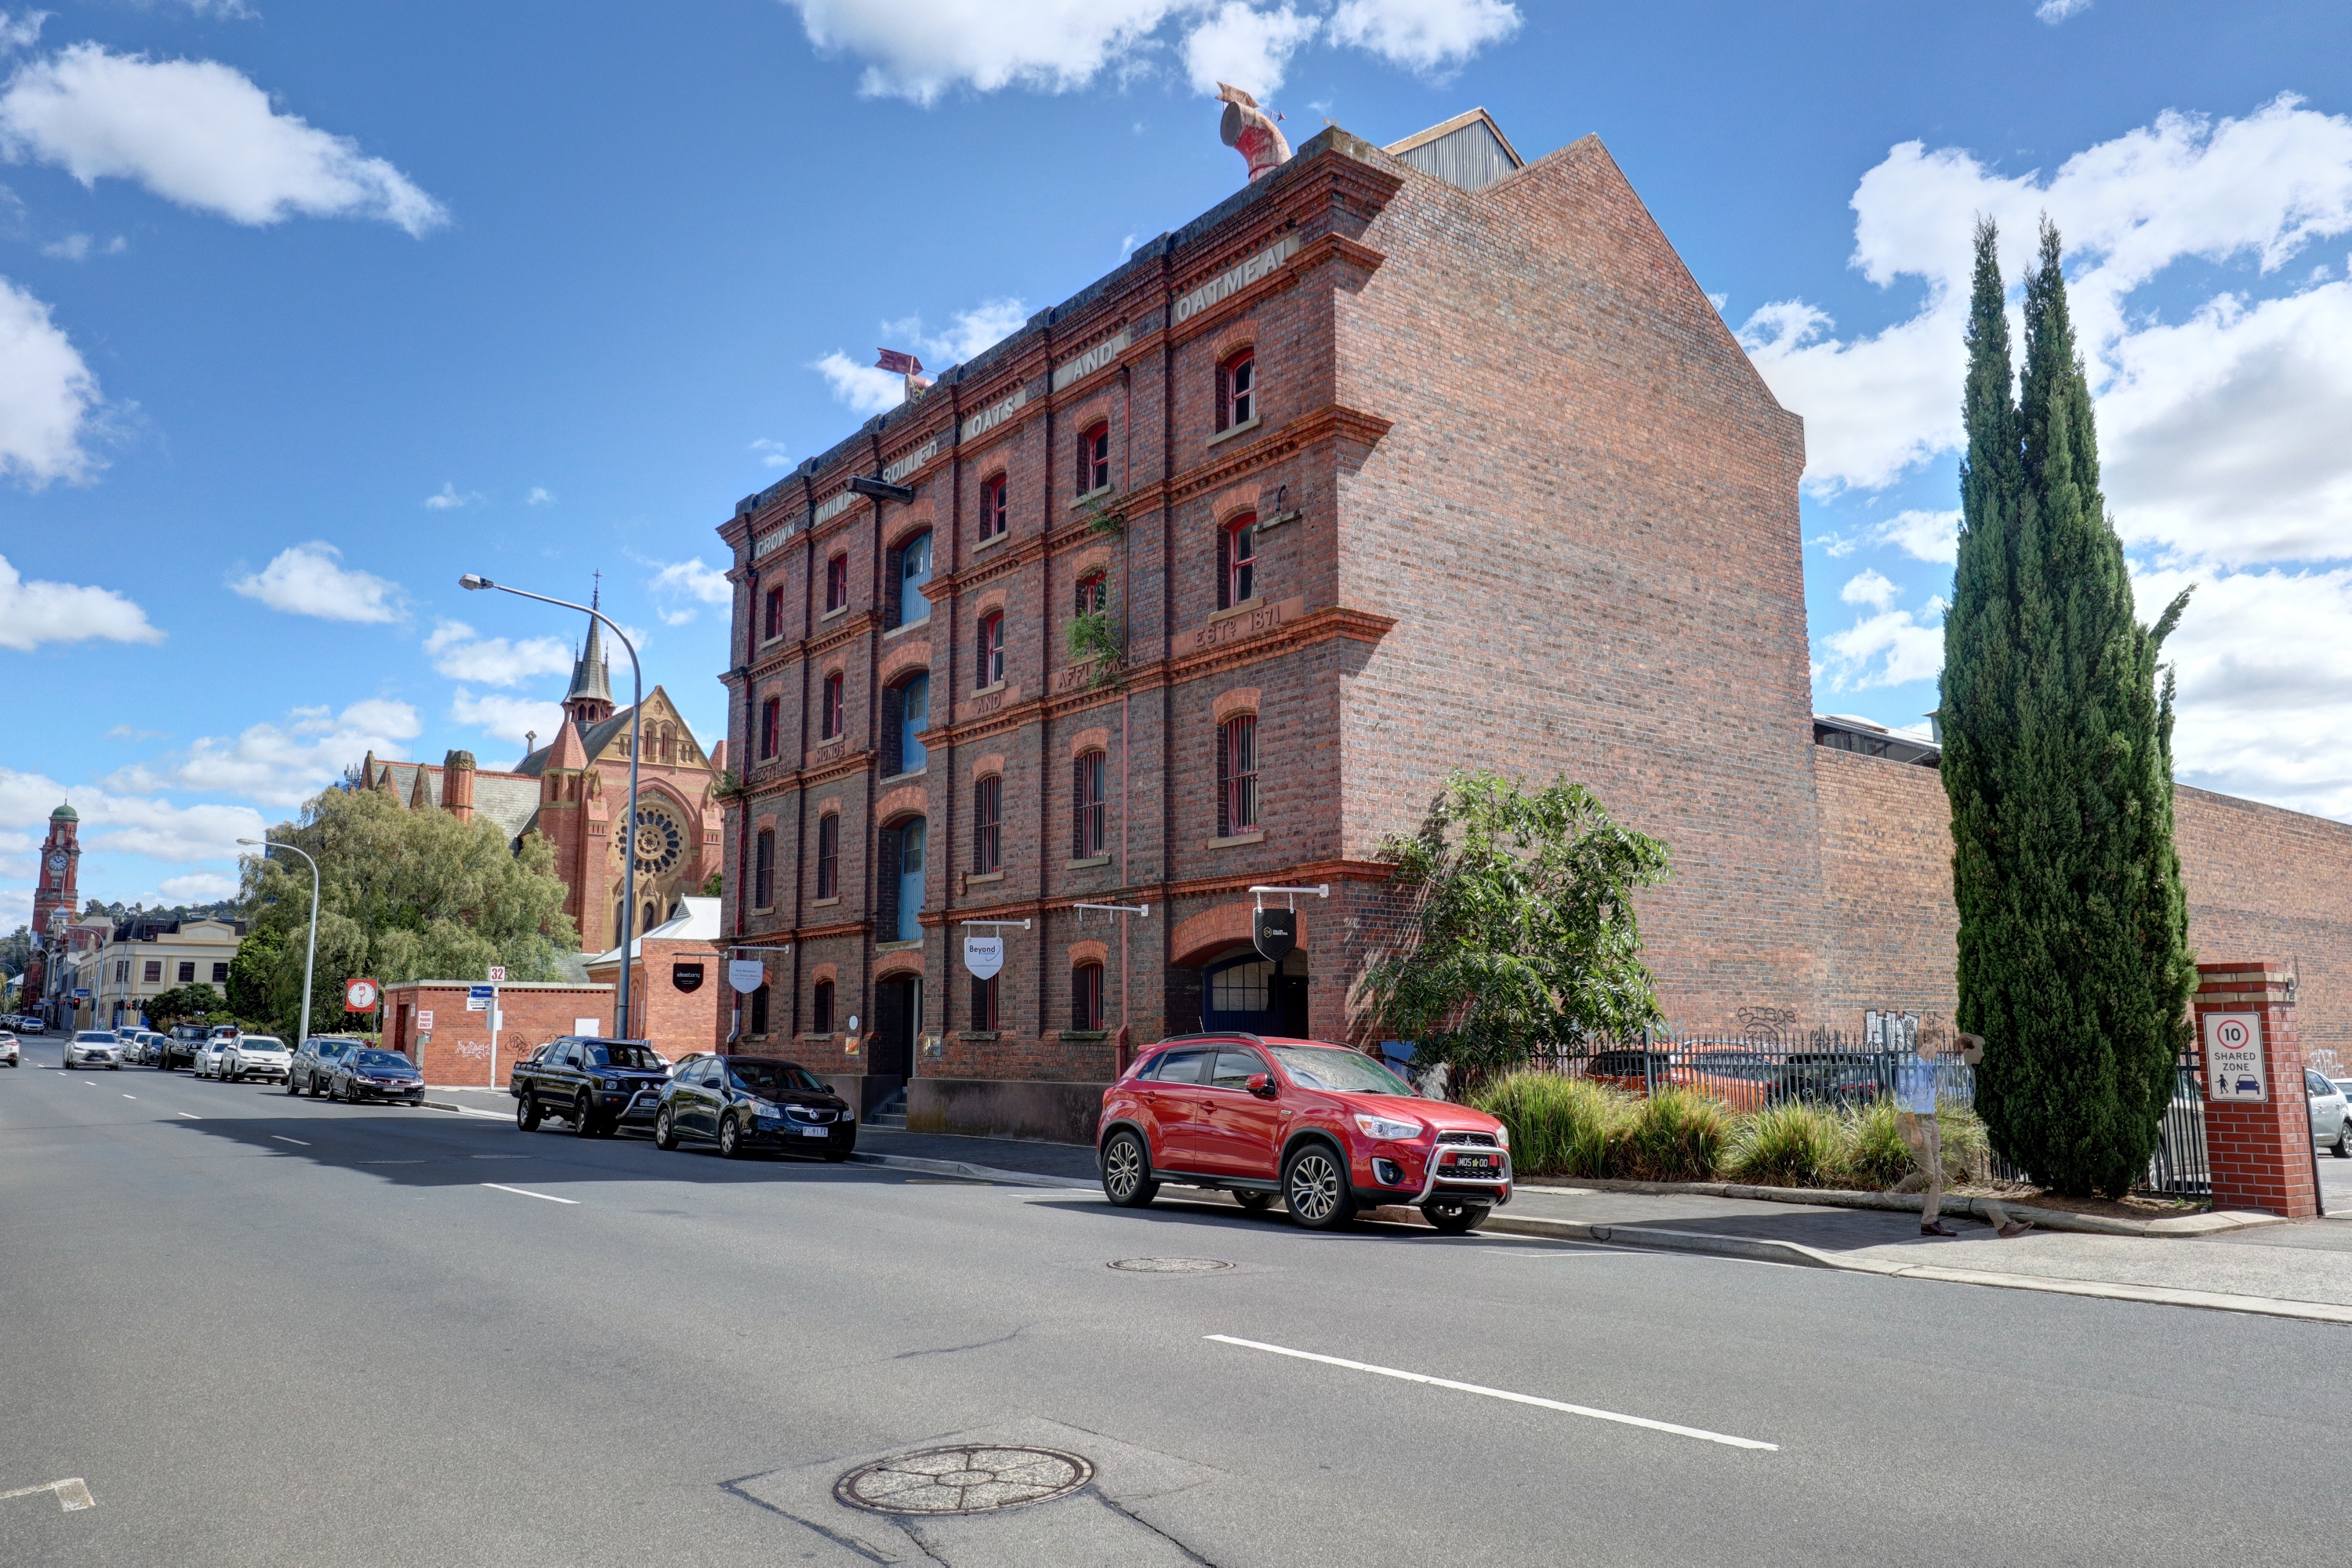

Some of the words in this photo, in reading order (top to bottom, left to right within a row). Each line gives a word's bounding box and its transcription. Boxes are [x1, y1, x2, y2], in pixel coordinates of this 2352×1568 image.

[757, 522, 795, 558] CROWN
[972, 397, 1015, 437] OATS
[1073, 341, 1113, 382] AND
[1248, 604, 1280, 631] 1871
[816, 742, 845, 763] MONDS
[978, 694, 1001, 713] AND
[969, 945, 996, 954] Beyond
[492, 968, 503, 979] 32
[2224, 1028, 2241, 1041] 10
[2214, 1052, 2256, 1061] SHARED
[1459, 1158, 1472, 1167] MOS
